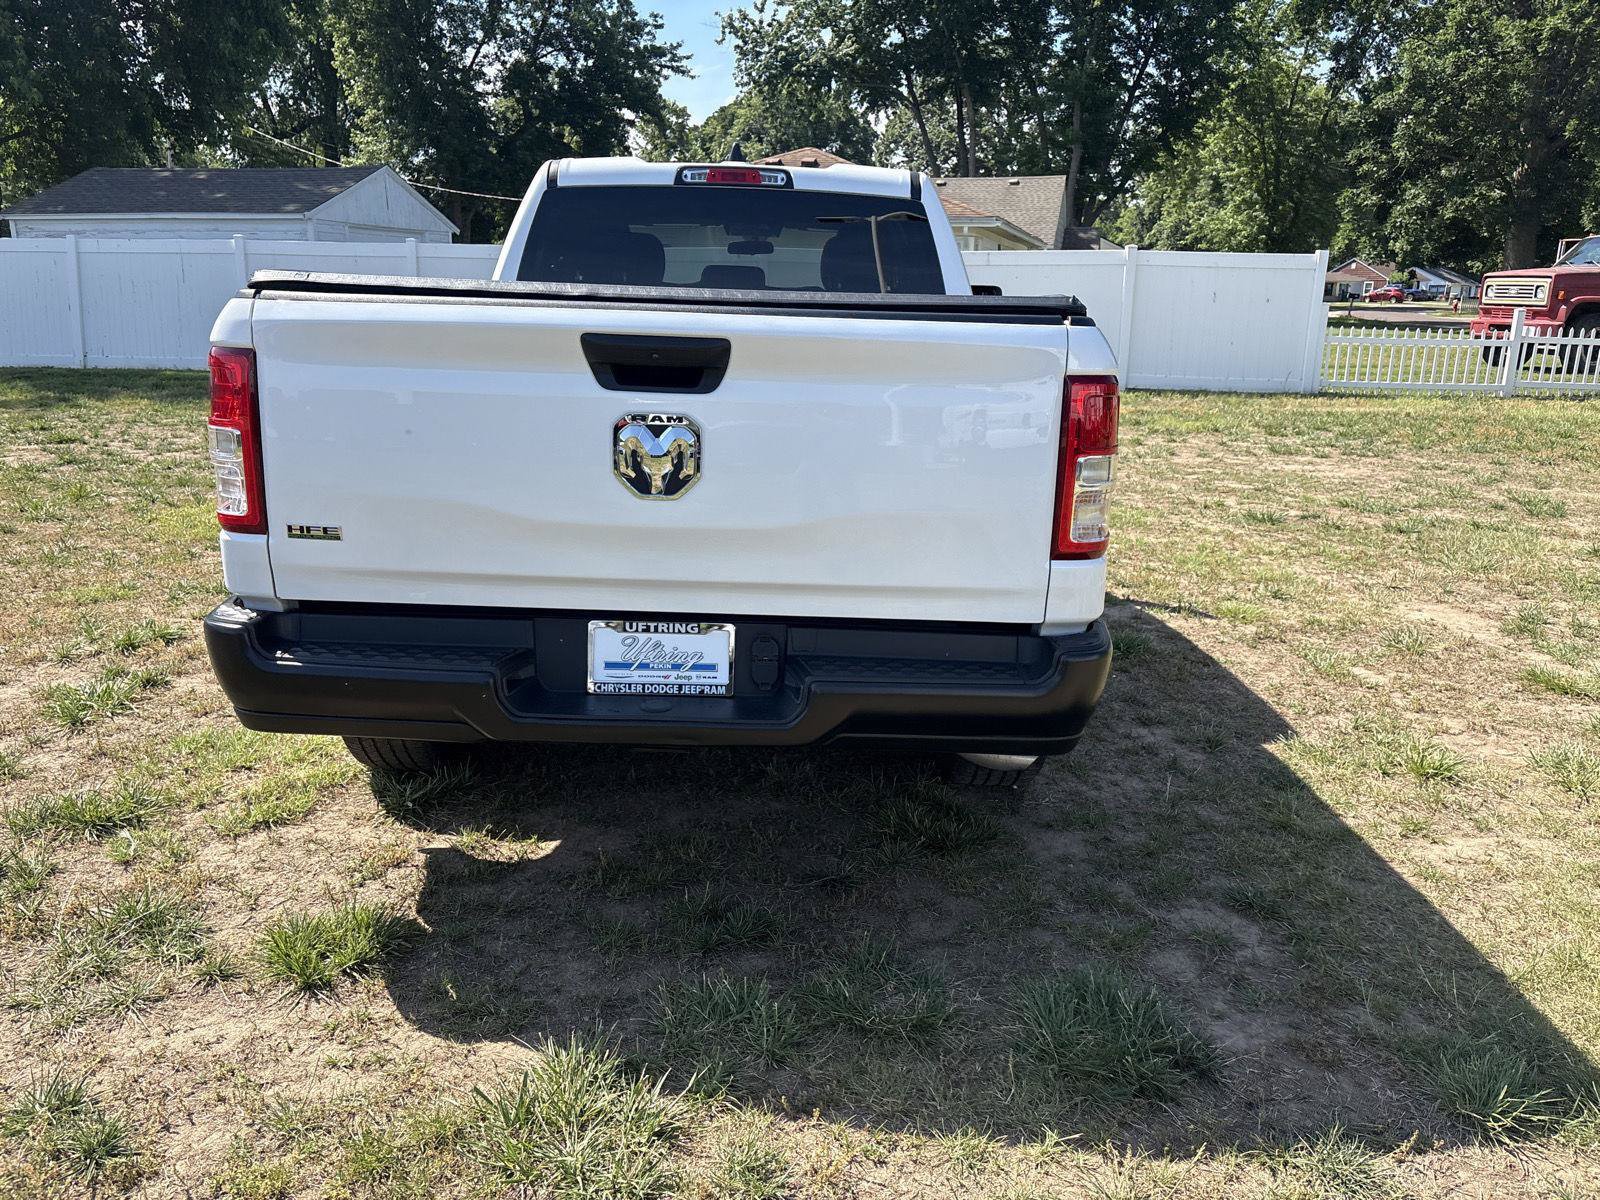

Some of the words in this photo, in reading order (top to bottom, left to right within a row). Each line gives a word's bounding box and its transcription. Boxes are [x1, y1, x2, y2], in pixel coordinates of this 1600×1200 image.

[631, 413, 685, 424] RAM
[287, 525, 340, 535] HFE
[625, 622, 699, 633] UFTRING
[621, 635, 704, 672] Uftring
[674, 673, 692, 681] Jeep
[594, 683, 643, 693] CHRYSLER
[645, 684, 678, 694] DODGE
[704, 685, 726, 695] RAM
